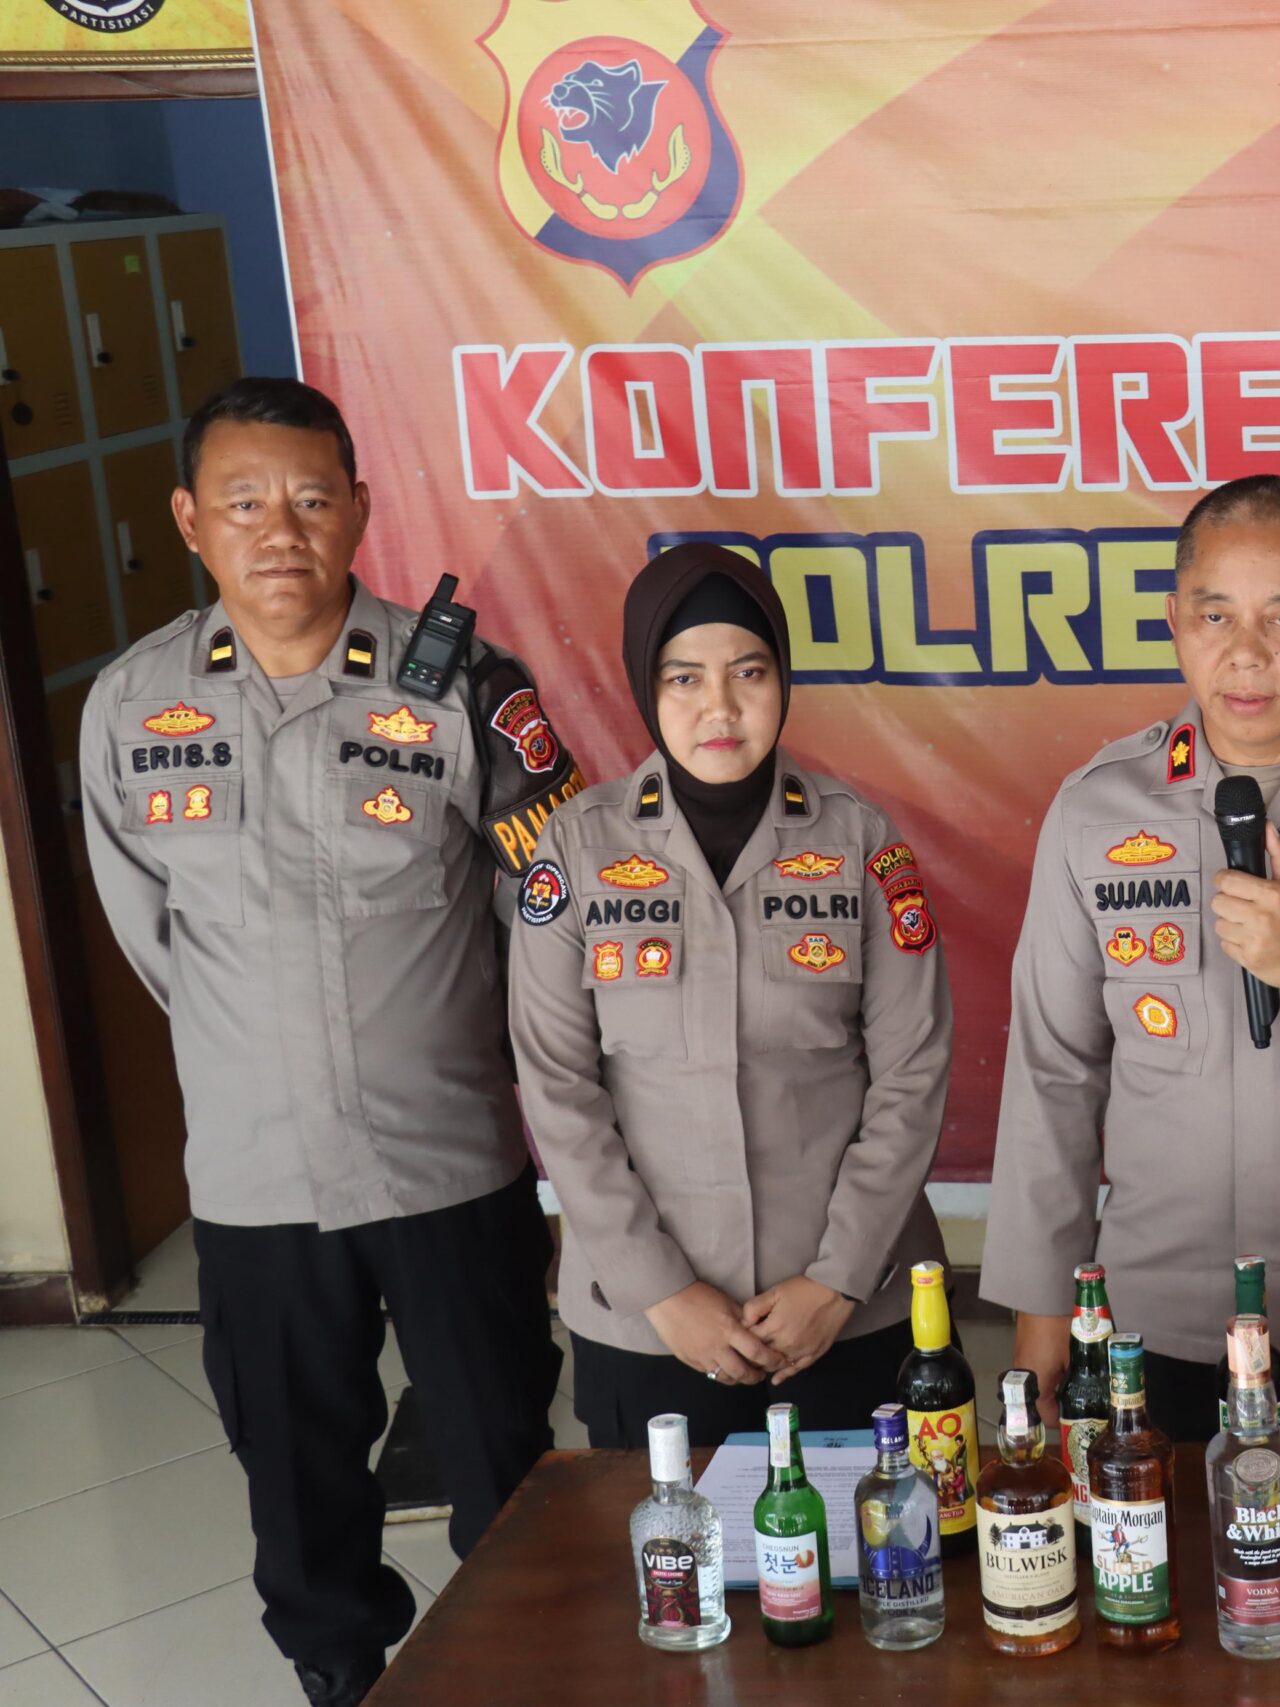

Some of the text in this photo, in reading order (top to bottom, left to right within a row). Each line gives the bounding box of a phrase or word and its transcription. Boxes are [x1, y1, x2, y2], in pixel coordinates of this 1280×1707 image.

[60, 4, 154, 30] PARTISIPASI
[648, 527, 1178, 685] OLRE
[340, 741, 445, 780] POLRI
[764, 894, 859, 919] POLRI
[1095, 879, 1191, 911] SUJANA
[586, 898, 680, 926] ANGGI
[917, 1412, 962, 1441] AO
[1121, 1509, 1163, 1529] Morgan
[985, 1547, 1068, 1573] BULWISK
[1097, 1554, 1153, 1576] SLICED
[862, 1573, 934, 1600] ICELAND
[1099, 1569, 1154, 1593] APPLE
[1246, 1587, 1279, 1596] VODKA
